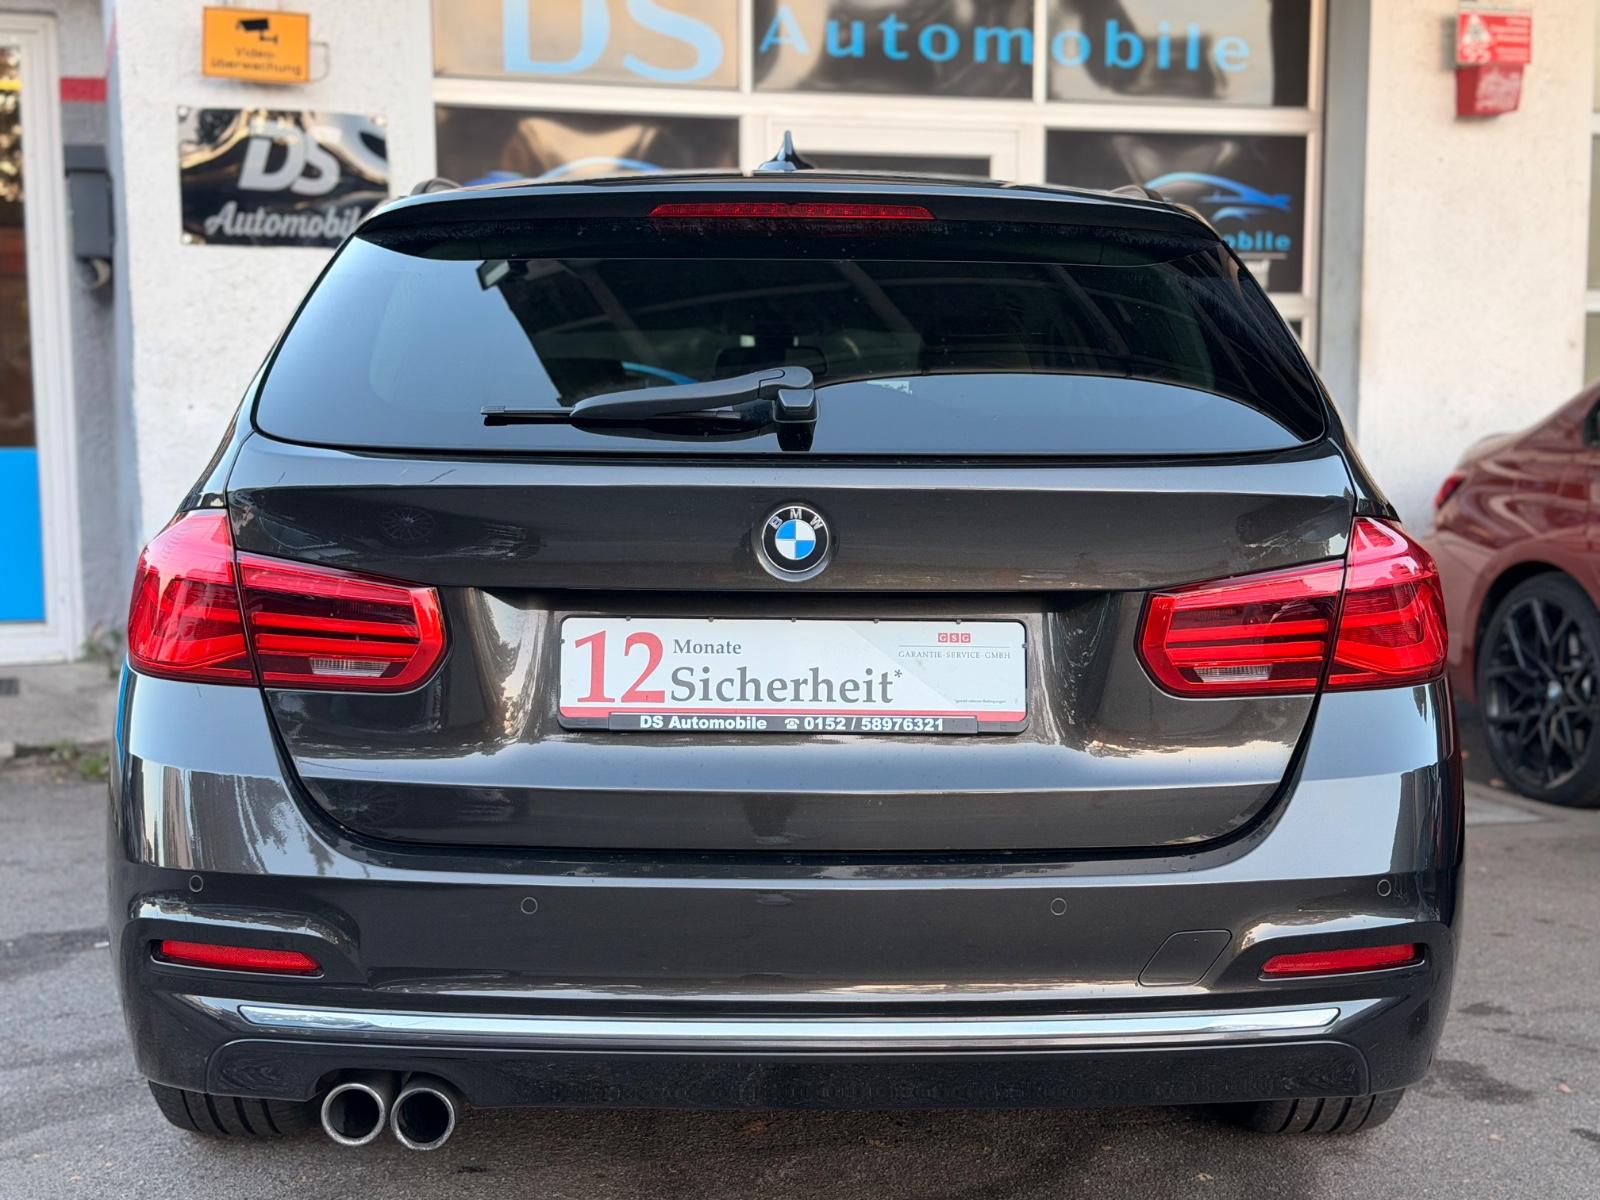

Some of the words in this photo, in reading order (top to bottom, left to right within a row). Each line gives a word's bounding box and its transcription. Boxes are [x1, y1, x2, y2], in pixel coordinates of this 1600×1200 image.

[503, 0, 723, 82] DS
[759, 6, 1250, 72] Automobile
[238, 119, 340, 195] DS
[205, 201, 361, 239] Automobil
[769, 508, 823, 530] BMW
[673, 639, 742, 655] Monate
[938, 633, 971, 643] GSG
[575, 630, 665, 703] 12
[640, 715, 664, 728] DS
[668, 716, 768, 730] Automobile
[804, 717, 846, 730] 0152
[861, 718, 944, 731] 58976321
